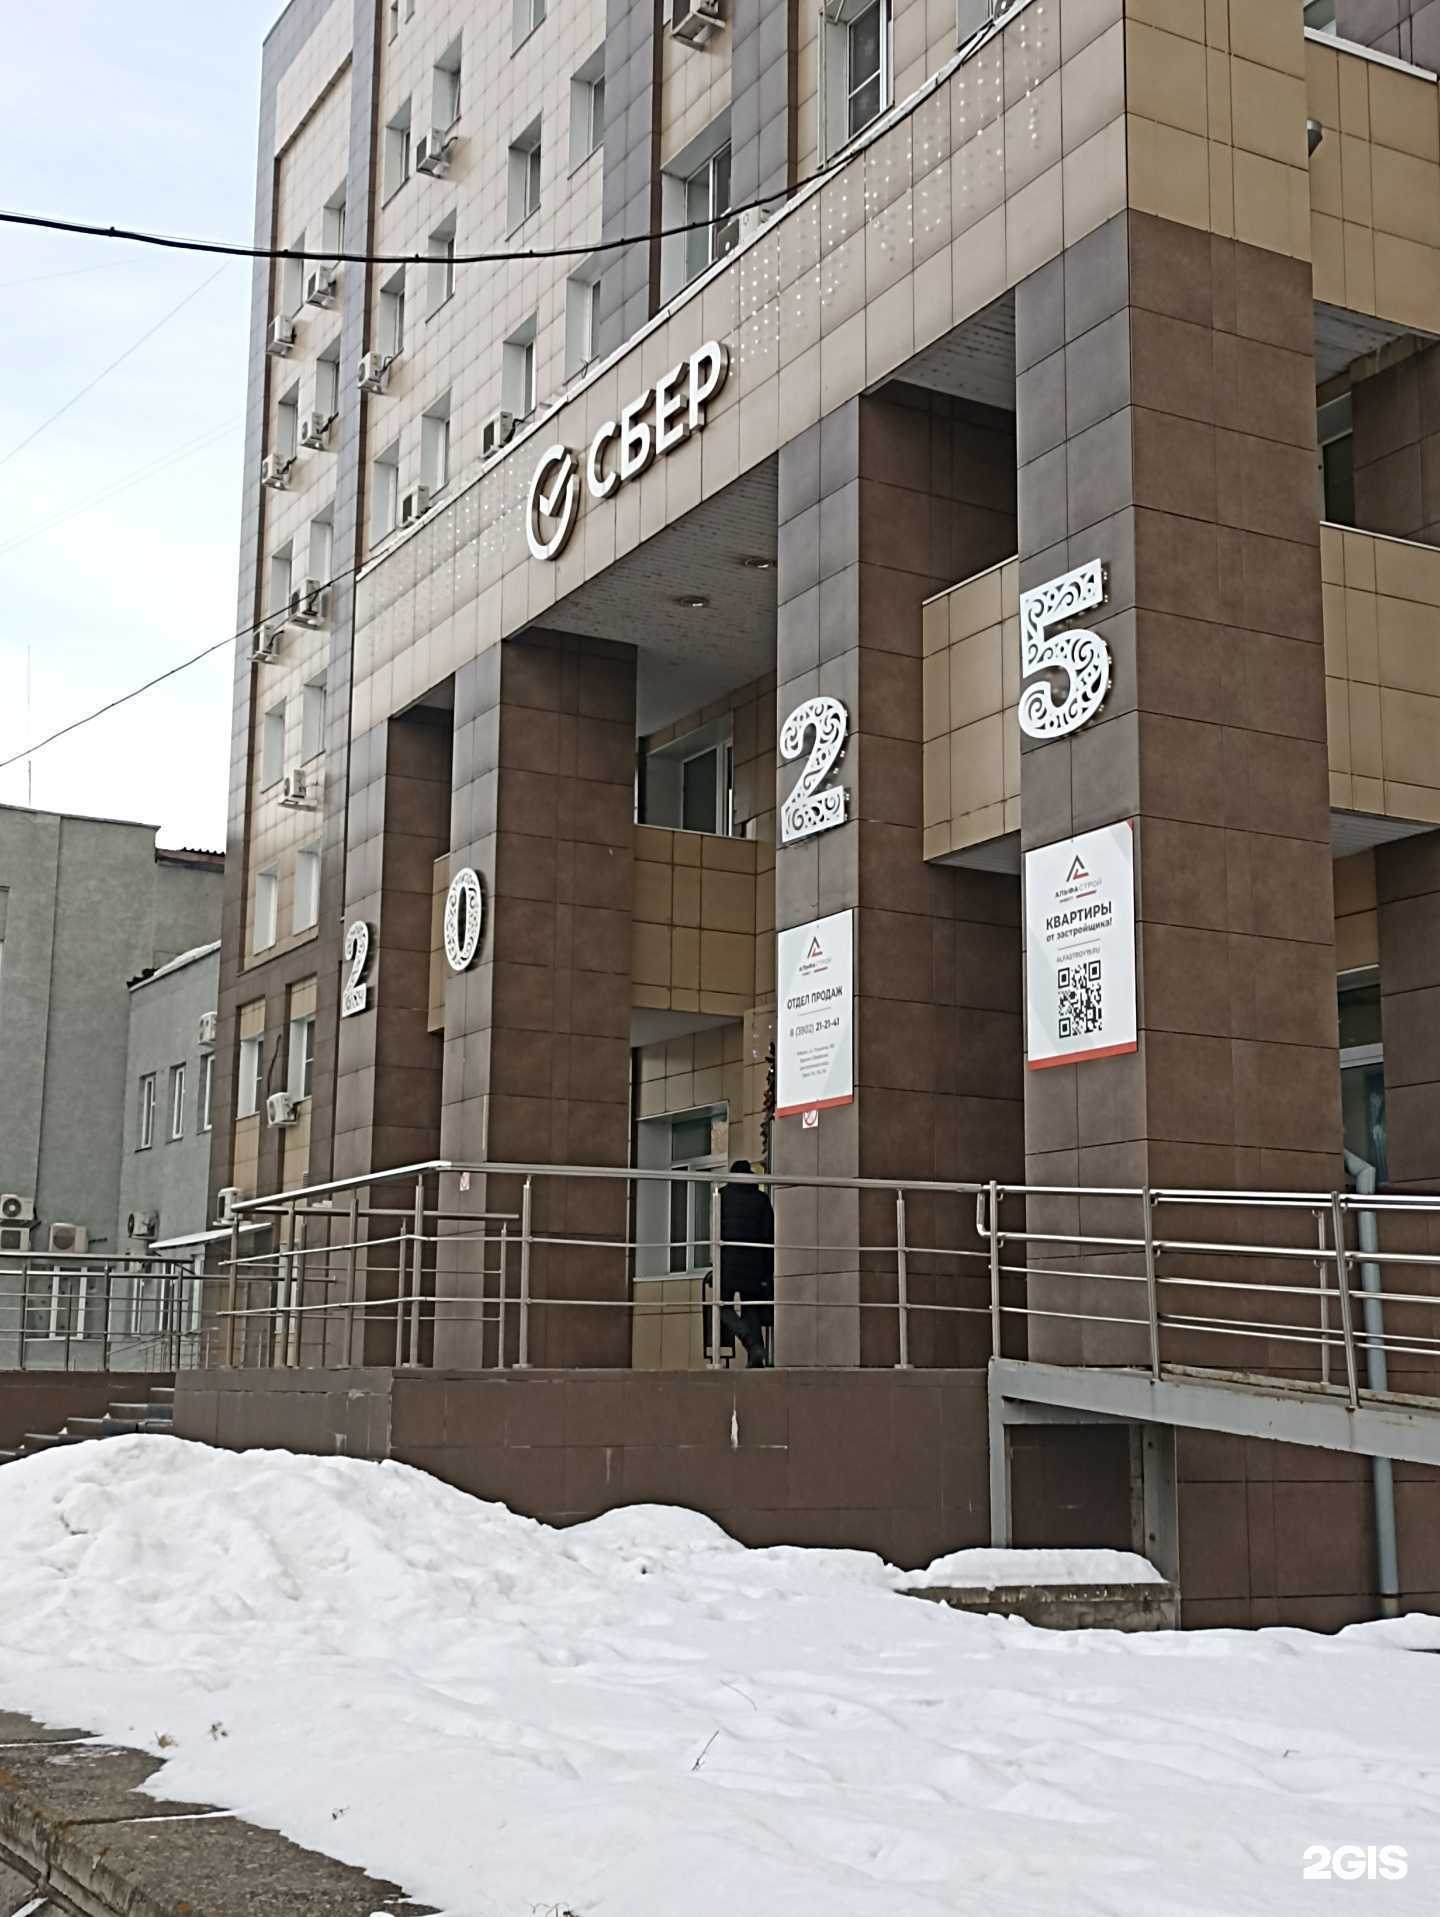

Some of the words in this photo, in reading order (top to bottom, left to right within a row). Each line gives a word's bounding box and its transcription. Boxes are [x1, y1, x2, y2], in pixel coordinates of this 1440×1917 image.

[587, 340, 728, 498] СБЕР
[1046, 901, 1112, 931] КВАРТИРЫ
[1046, 934, 1055, 942] от
[1056, 917, 1112, 940] застройщика!
[787, 994, 810, 1010] ОТДЕЛ
[811, 986, 843, 1004] ПРОДАЖ
